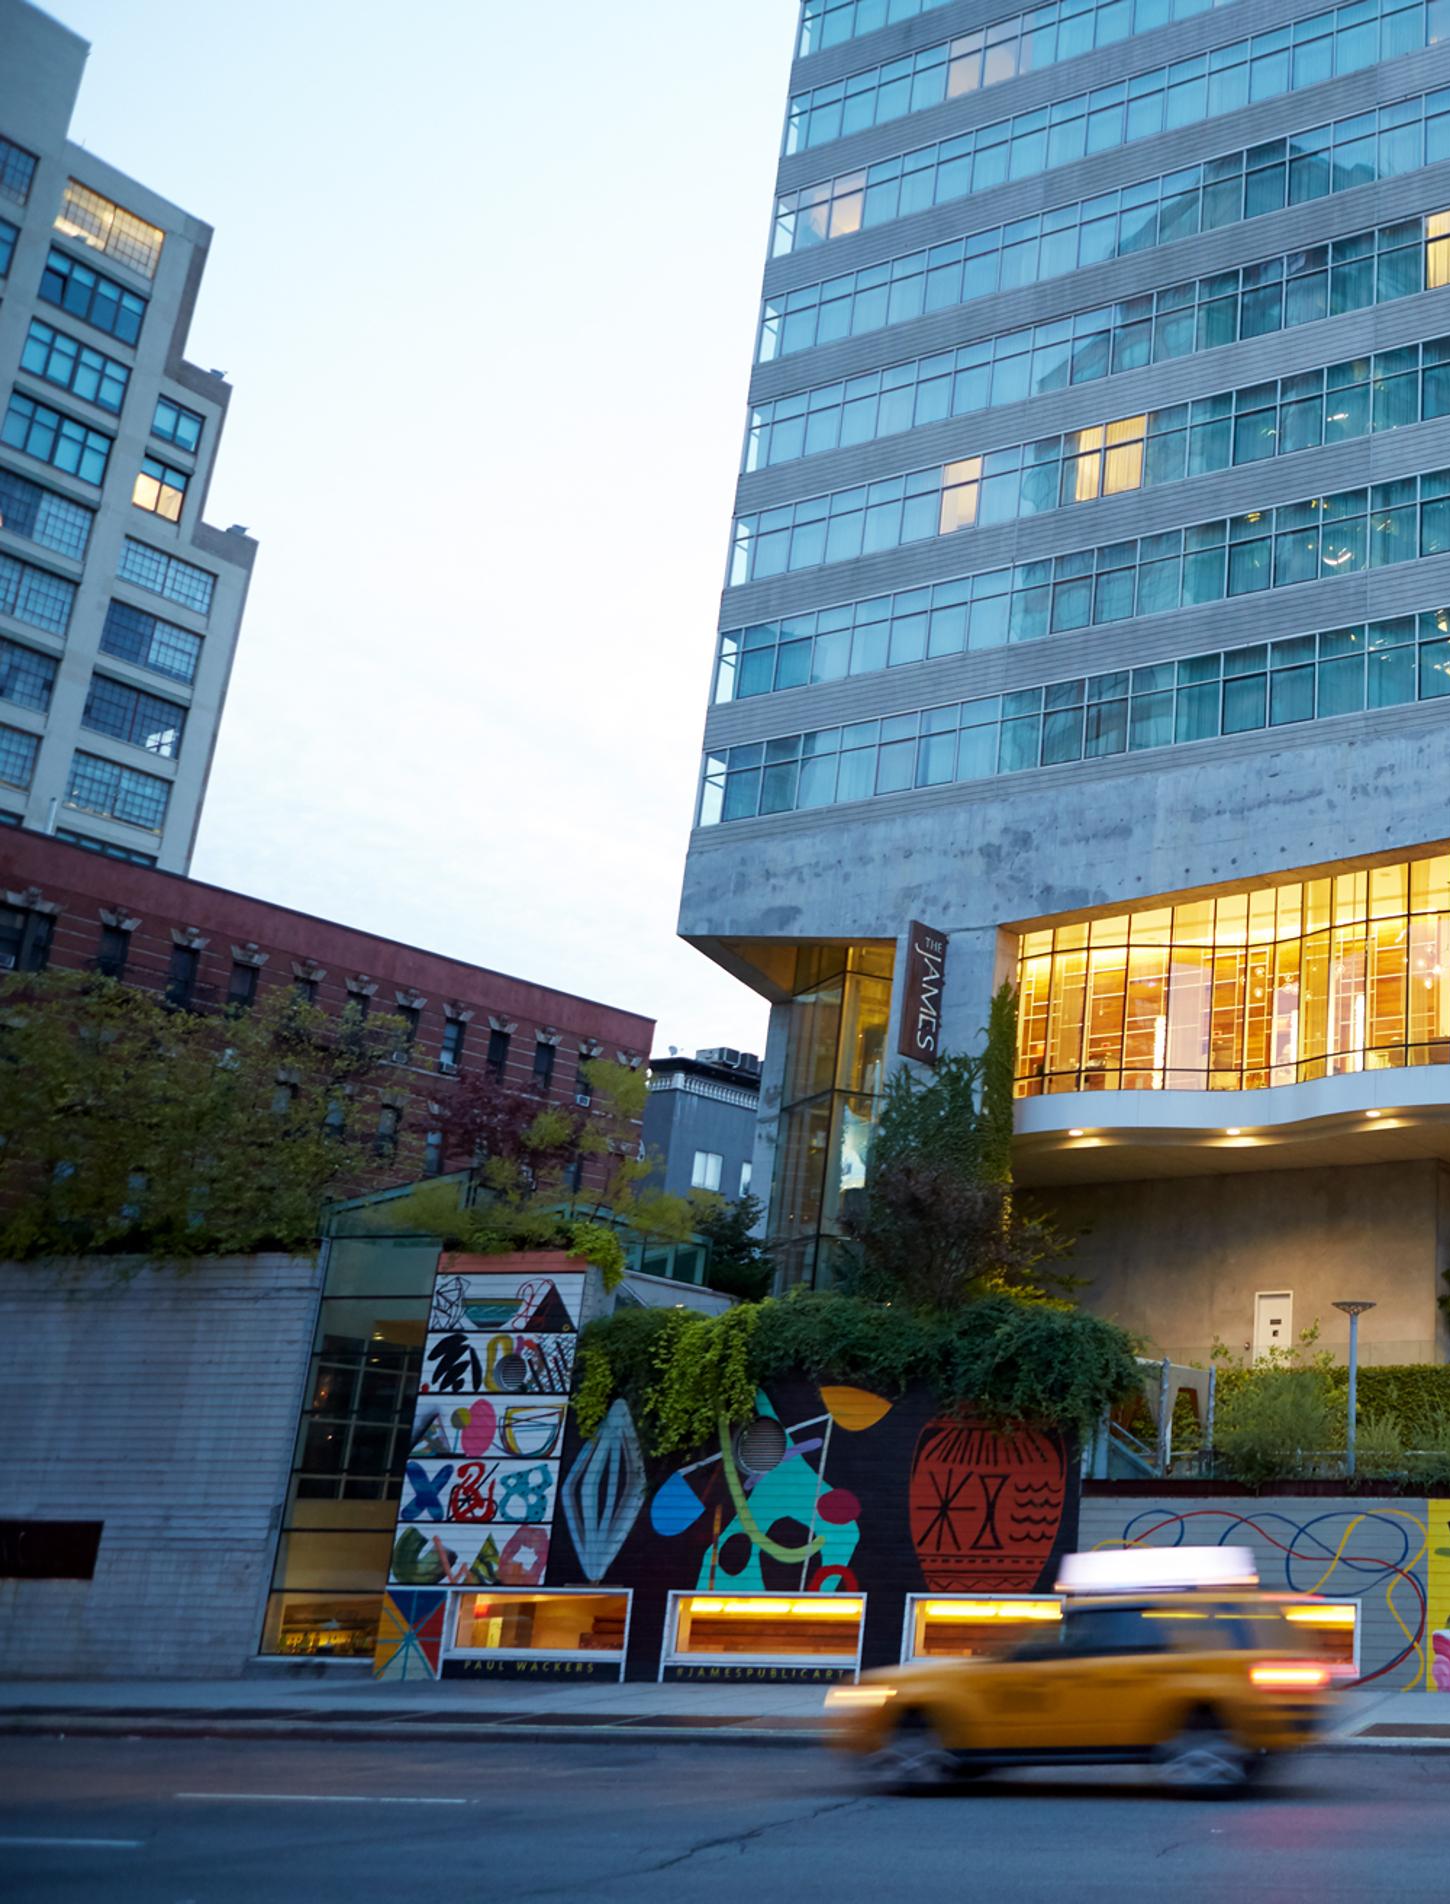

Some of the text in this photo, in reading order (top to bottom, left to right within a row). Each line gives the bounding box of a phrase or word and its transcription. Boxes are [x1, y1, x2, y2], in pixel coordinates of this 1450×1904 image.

[924, 936, 943, 953] THE
[914, 942, 942, 1052] JAMES
[463, 1659, 594, 1674] PAUL WACKERS
[676, 1666, 844, 1679] #JAMESPUBLICART
